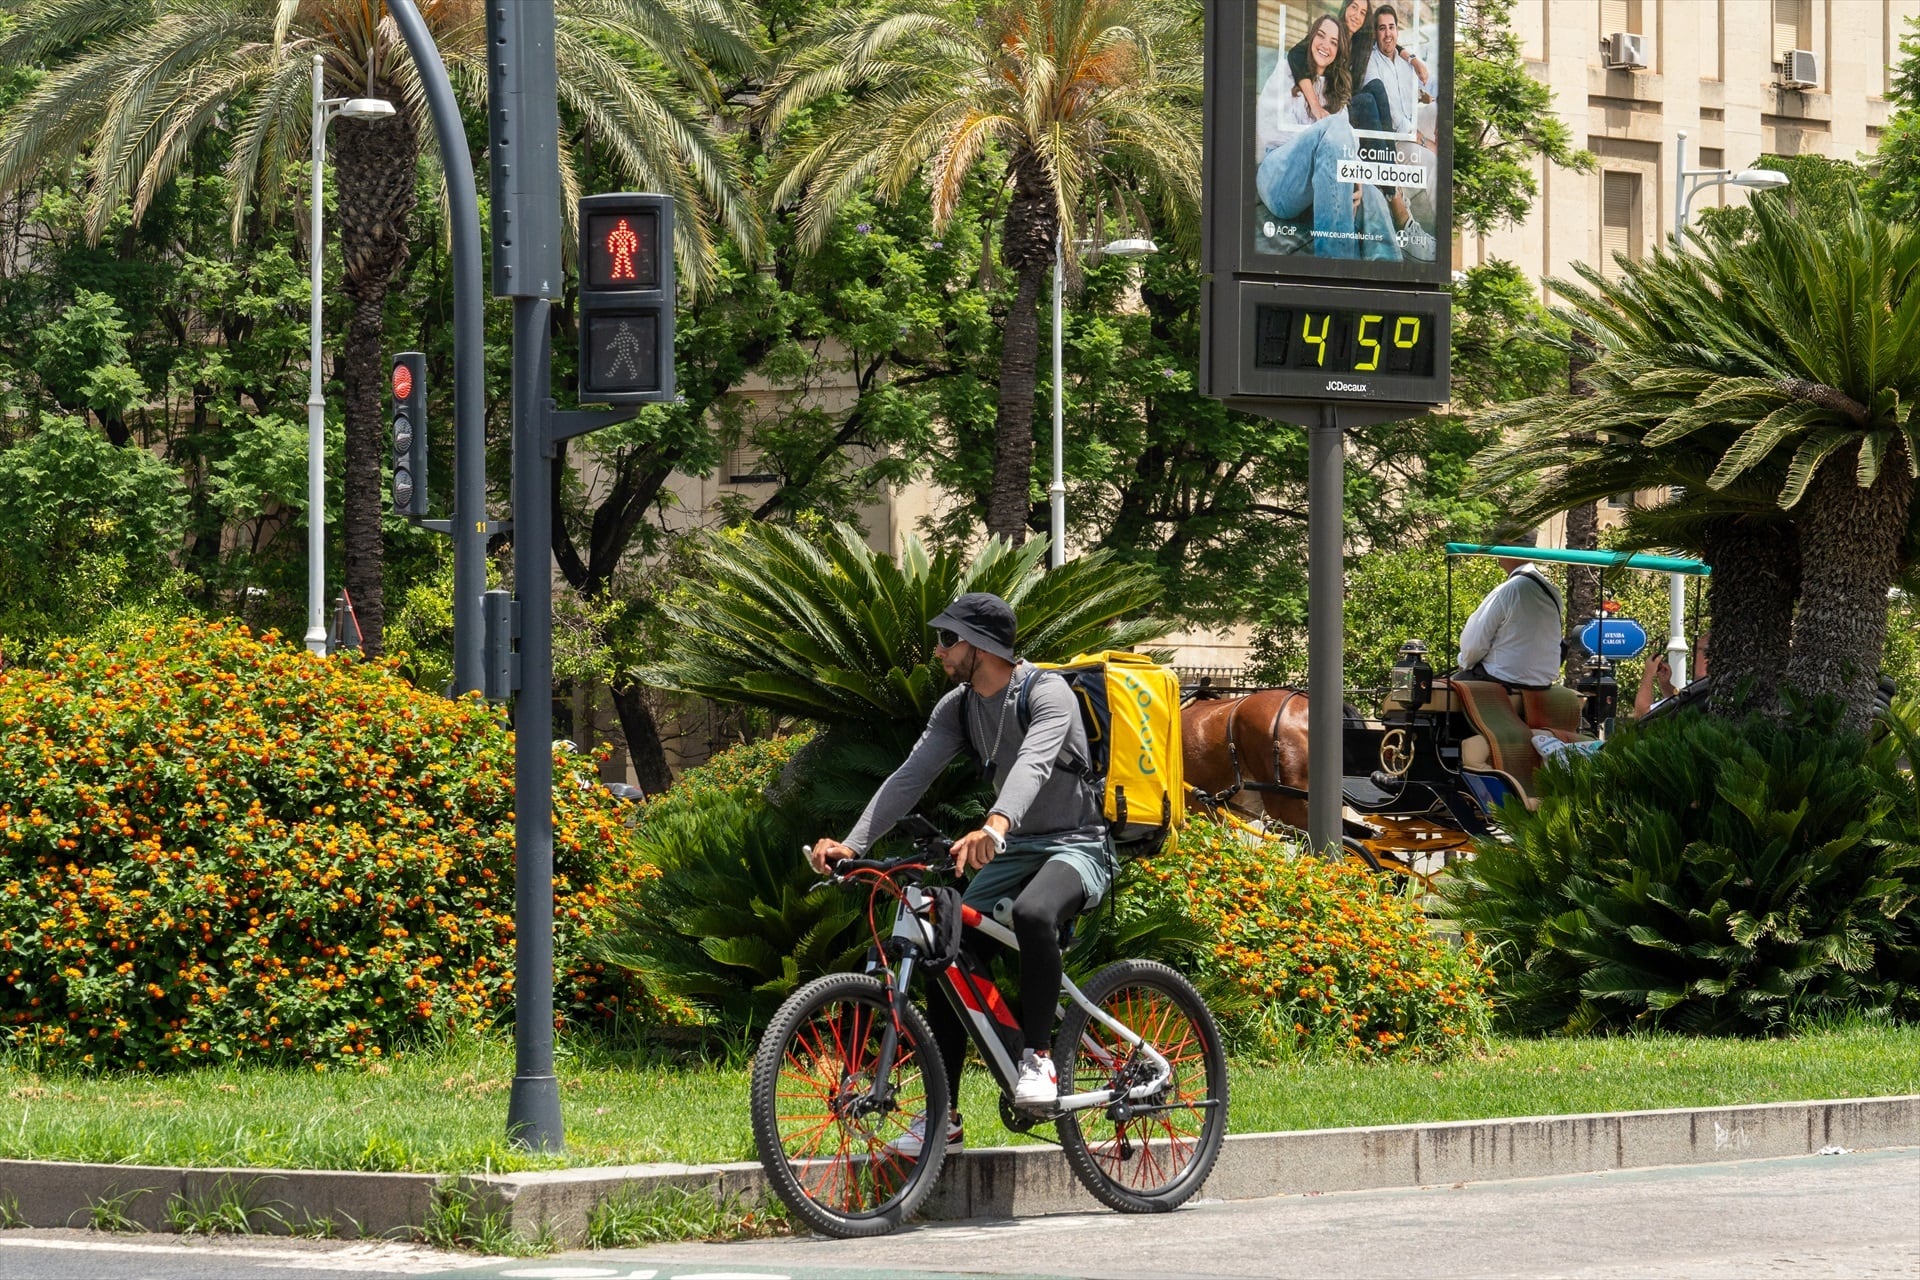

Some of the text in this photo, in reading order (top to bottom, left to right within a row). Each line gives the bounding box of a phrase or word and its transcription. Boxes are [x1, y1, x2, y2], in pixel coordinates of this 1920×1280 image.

[1343, 144, 1422, 163] tu camino al
[1341, 164, 1423, 184] éxito laboral
[1276, 226, 1297, 236] ACdP
[1325, 380, 1367, 393] JCDecaux
[475, 521, 486, 533] 11
